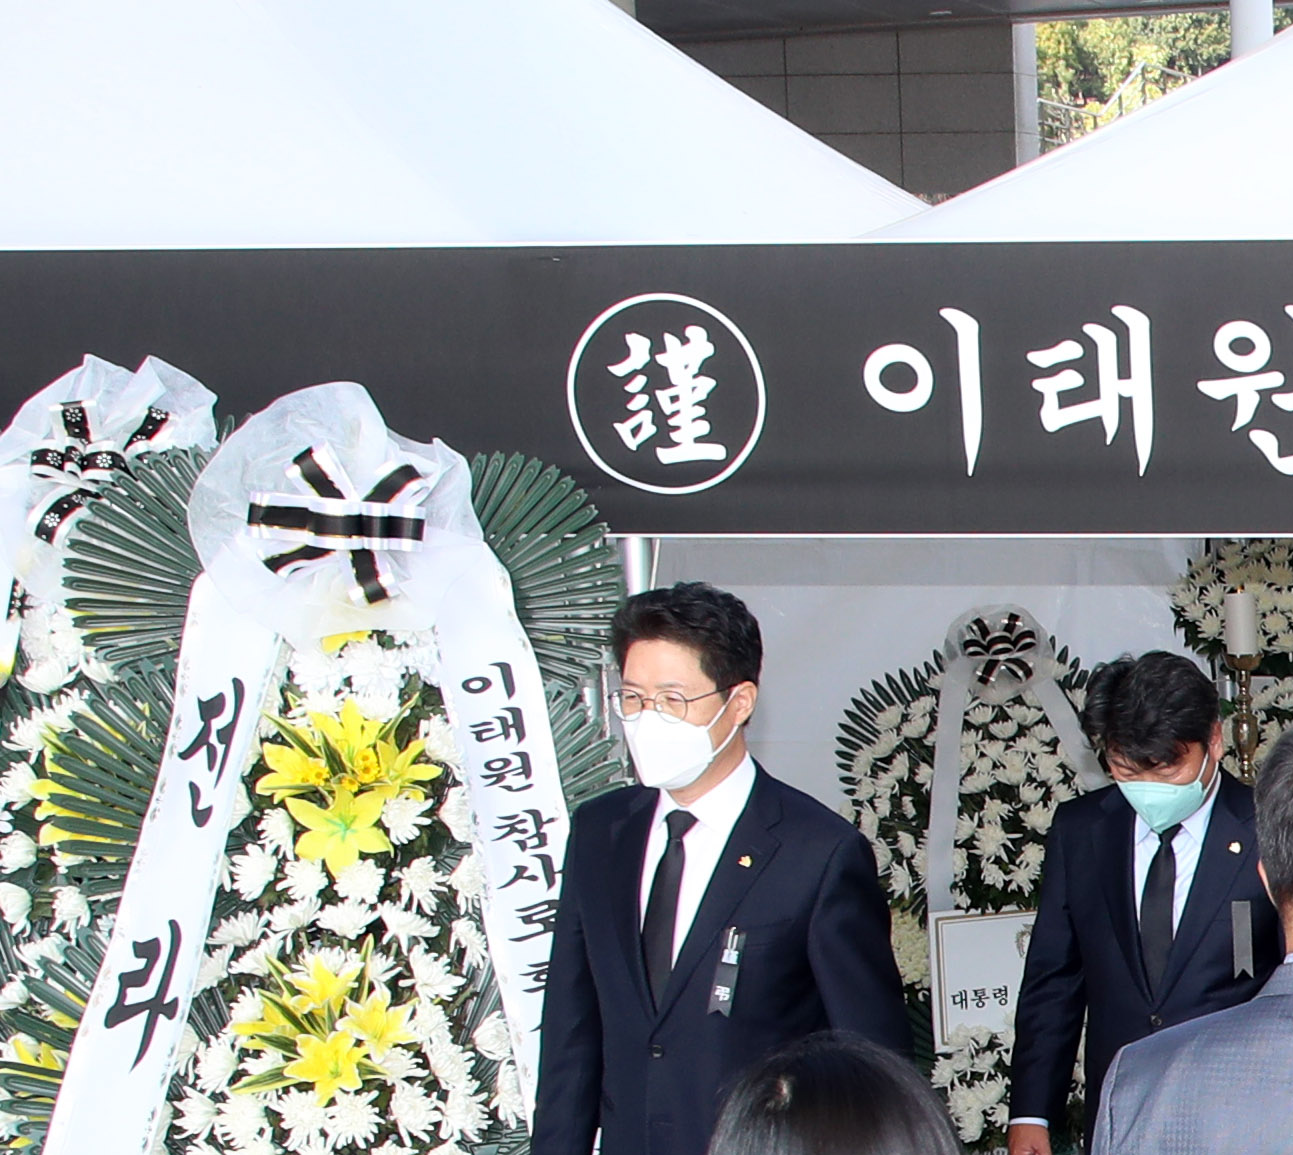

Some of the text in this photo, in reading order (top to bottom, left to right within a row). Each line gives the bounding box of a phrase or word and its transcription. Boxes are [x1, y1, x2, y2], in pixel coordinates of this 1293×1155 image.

[607, 326, 727, 464] 謹
[461, 661, 534, 792] 이태원
[951, 985, 1009, 1010] 대통령
